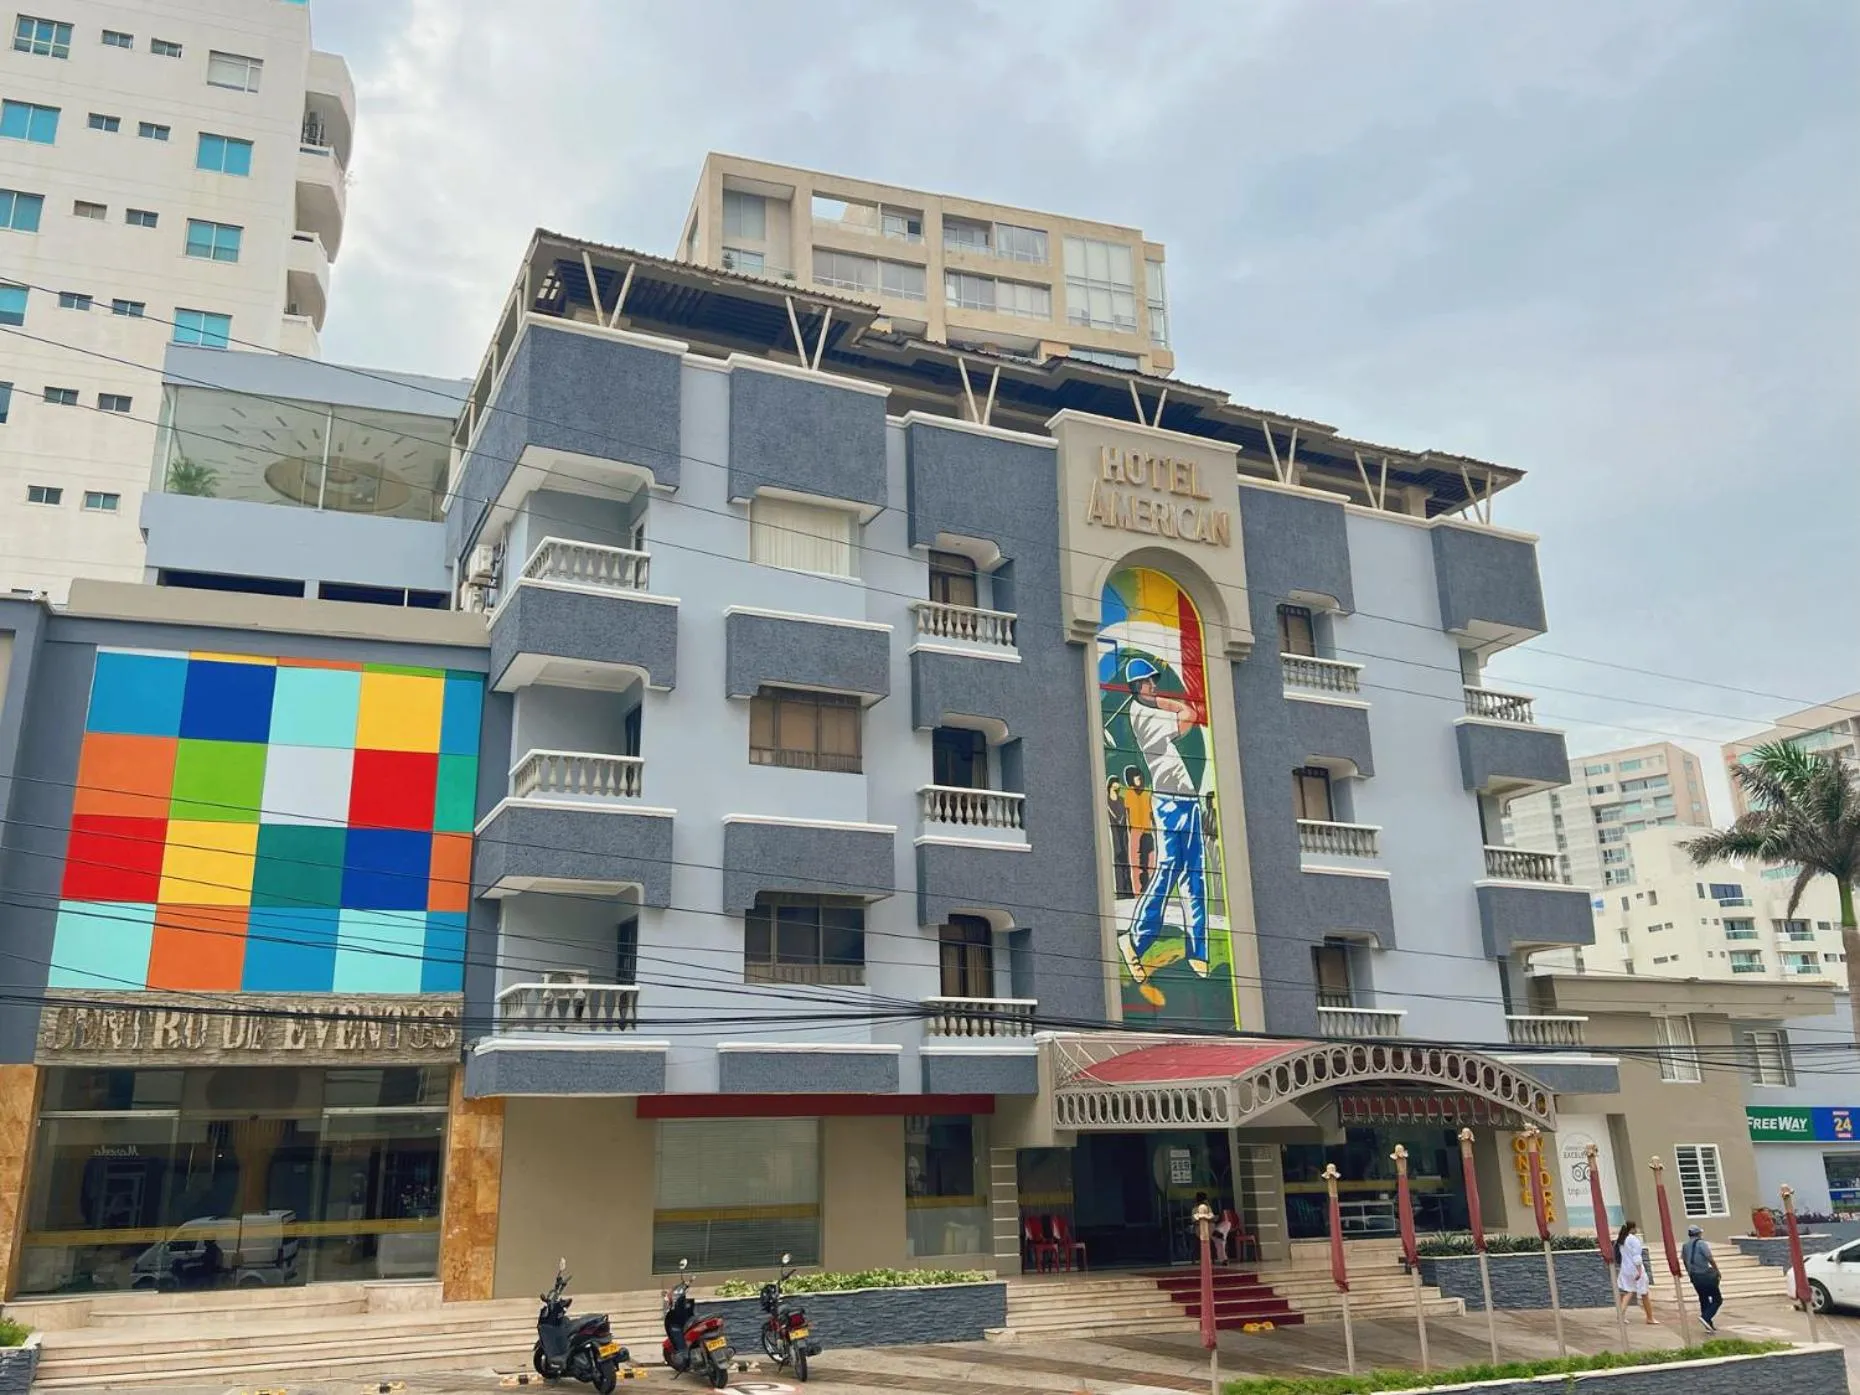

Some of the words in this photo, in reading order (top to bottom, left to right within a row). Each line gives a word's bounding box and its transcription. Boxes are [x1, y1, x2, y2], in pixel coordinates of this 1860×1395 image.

[1100, 446, 1212, 500] HOTEL
[1087, 478, 1231, 547] AMERICAN
[284, 1004, 457, 1050] EVENTOS
[1833, 1117, 1853, 1132] 24
